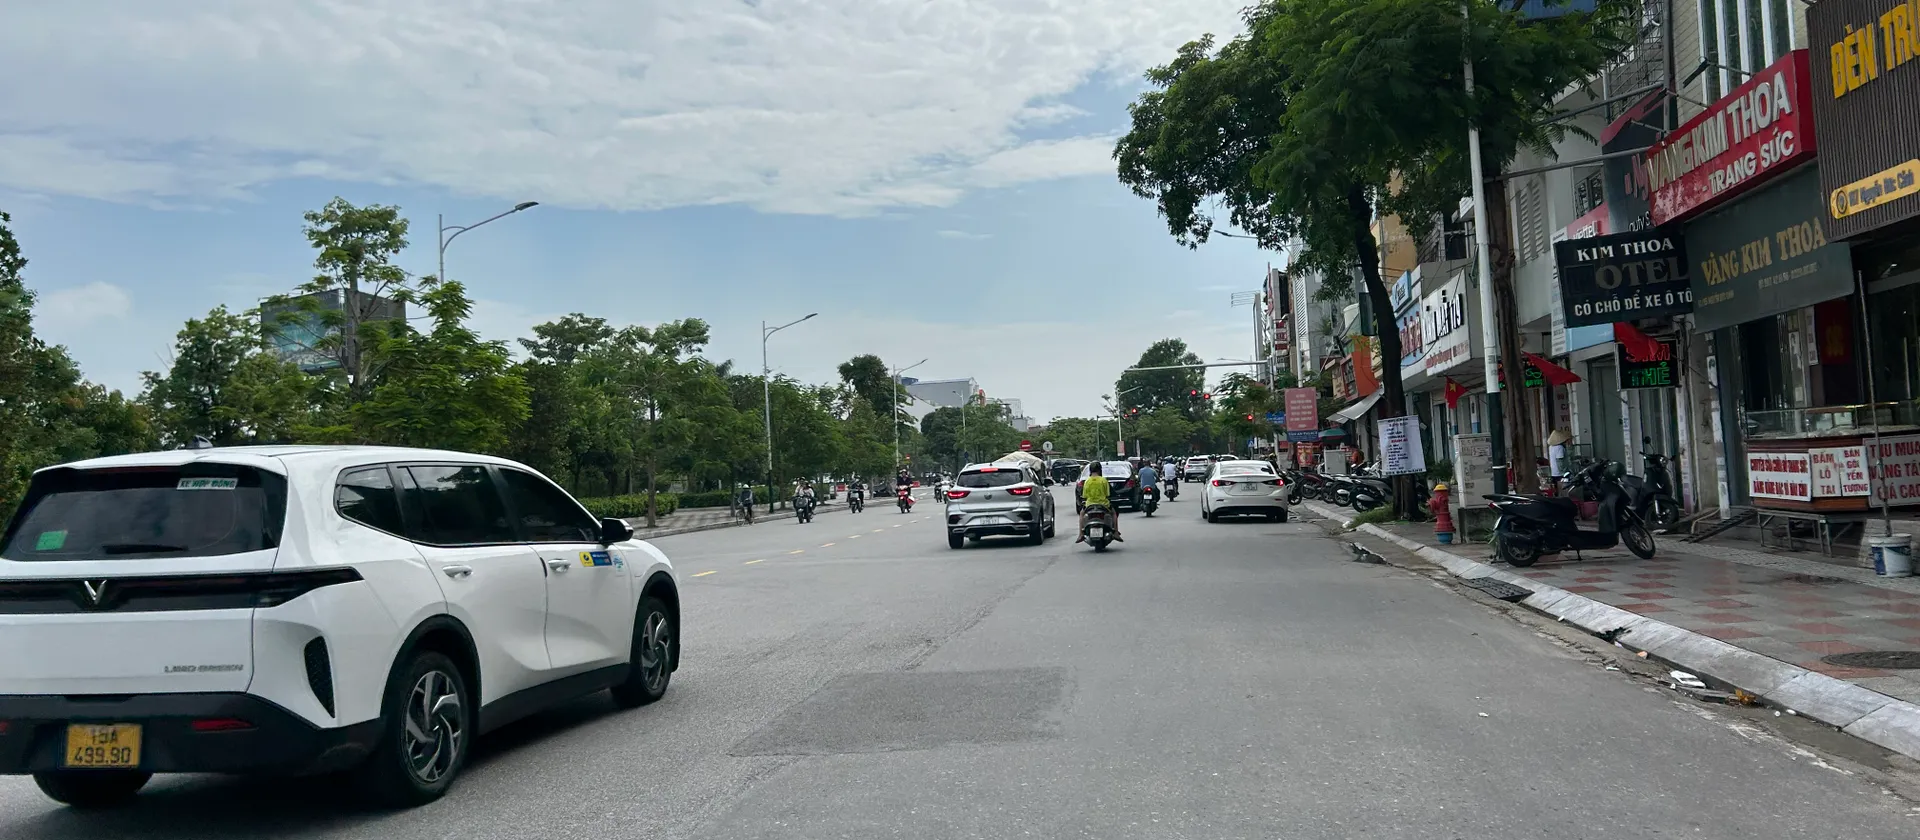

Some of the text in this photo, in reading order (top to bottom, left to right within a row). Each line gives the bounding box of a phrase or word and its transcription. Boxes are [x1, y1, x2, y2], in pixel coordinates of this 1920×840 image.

[1830, 23, 1879, 100] ĐÈN
[1647, 132, 1694, 193] VÀNG
[1691, 109, 1729, 167] KIM
[1727, 70, 1792, 145] THOA
[1708, 127, 1795, 196] TRANG SỨC
[1577, 238, 1675, 261] KIM THOA
[1701, 250, 1739, 286] VÀNG
[1741, 237, 1772, 273] KIM
[1776, 217, 1827, 261] THOA
[1595, 256, 1690, 290] OTEL
[1575, 300, 1591, 316] CÓ
[1595, 293, 1620, 314] CHỖ
[1645, 294, 1661, 308] XE
[1665, 290, 1674, 305] Ô
[1677, 287, 1693, 303] TÔ
[1627, 361, 1671, 387] THẺ
[1868, 464, 1902, 480] VNG
[1821, 485, 1836, 495] TAI
